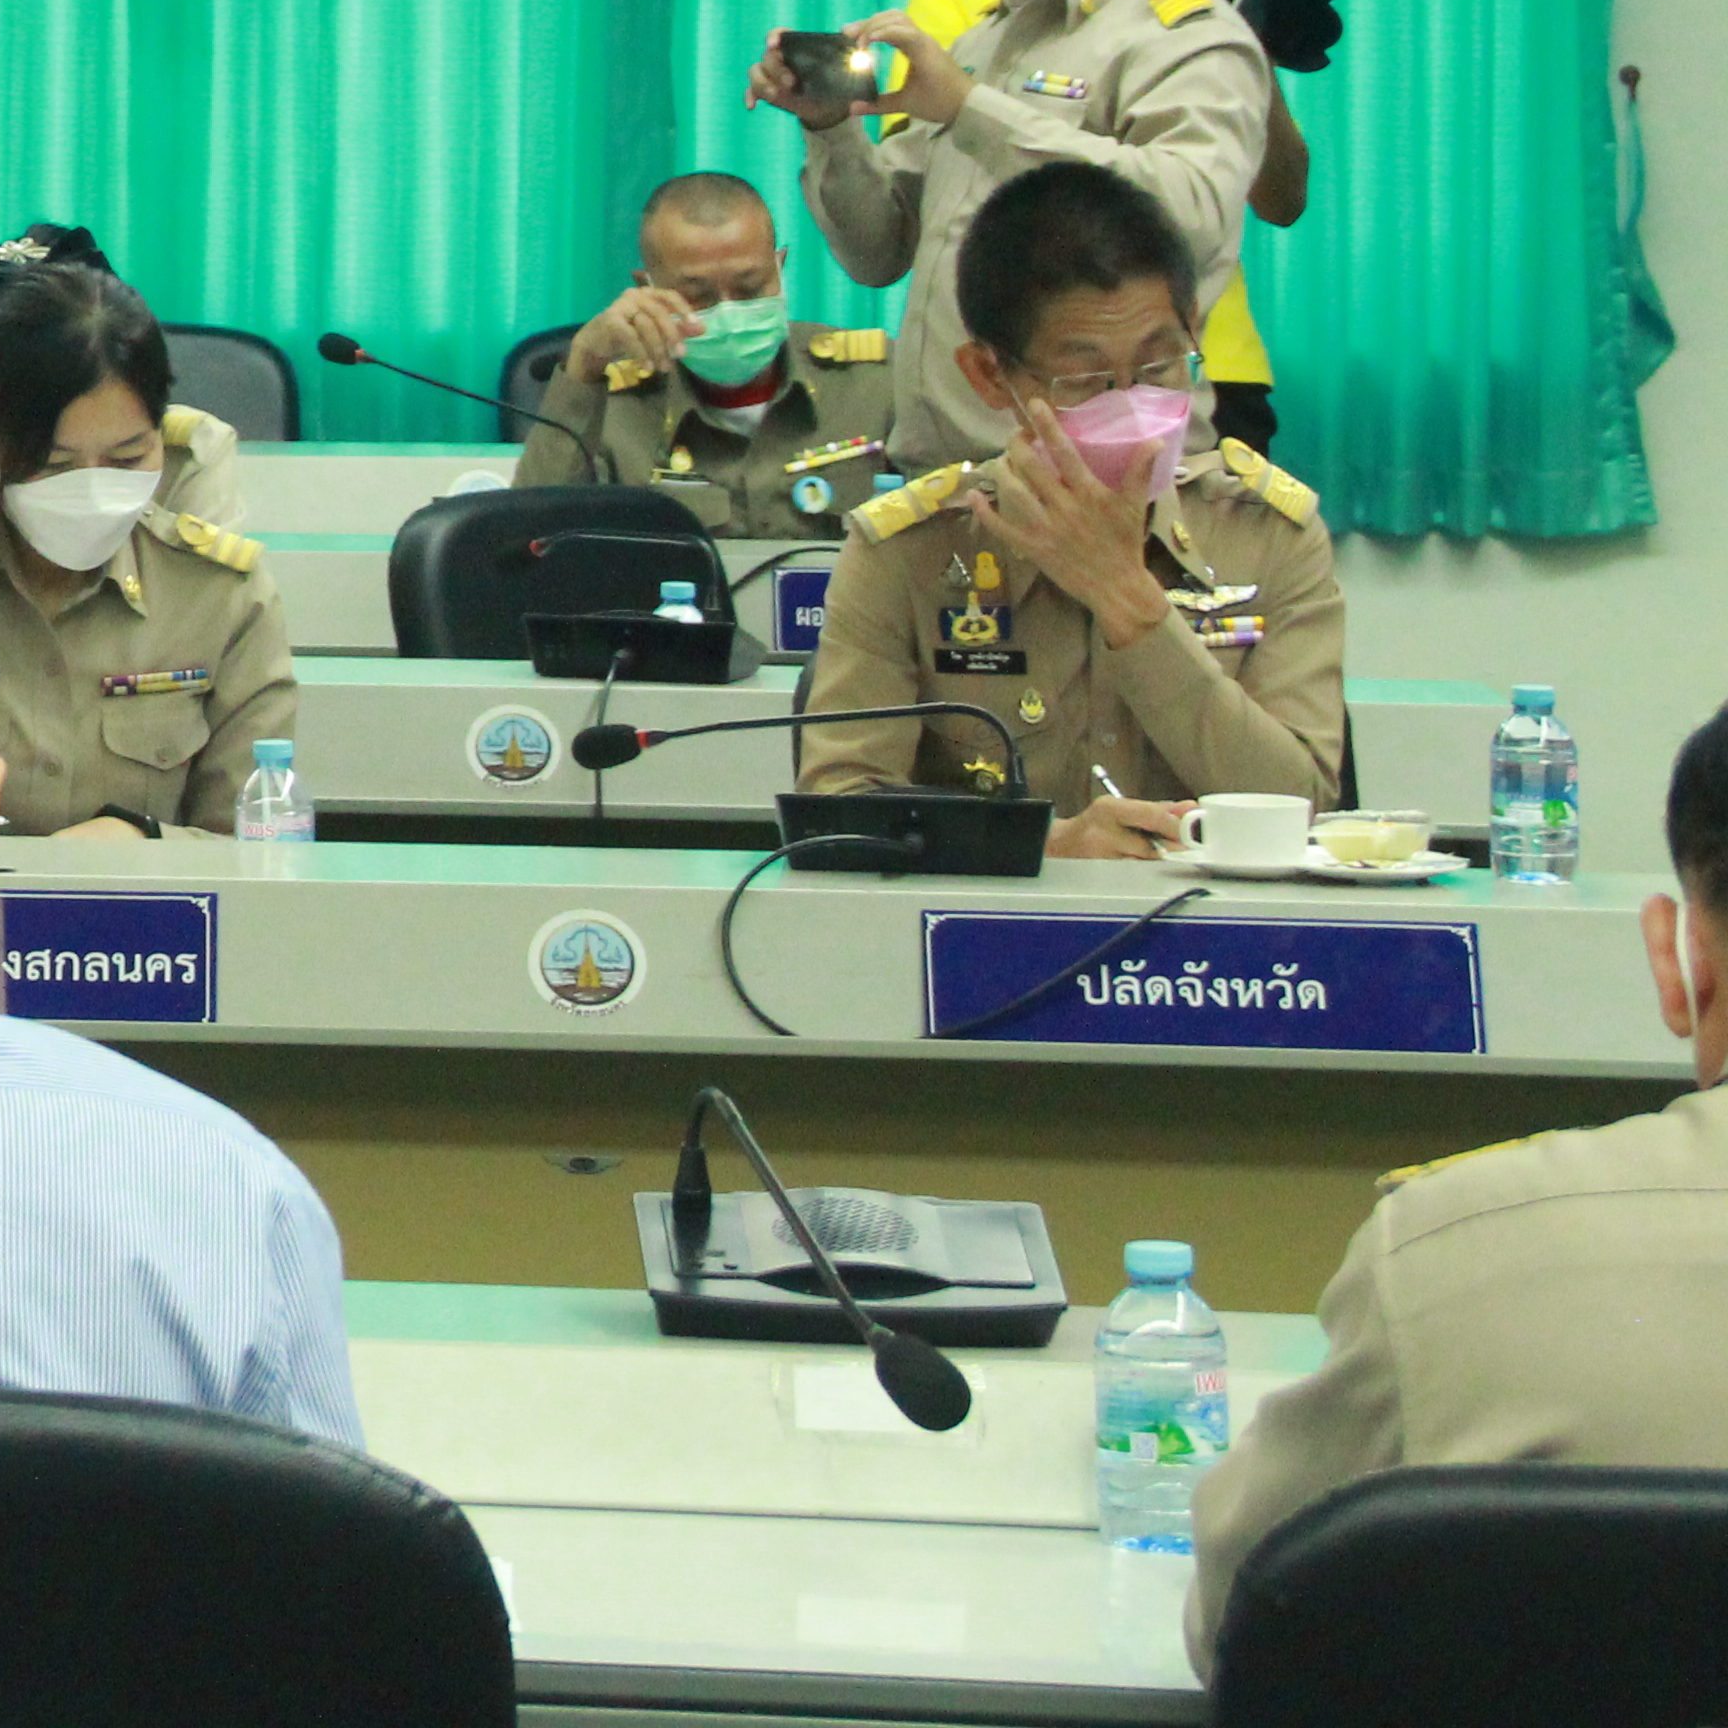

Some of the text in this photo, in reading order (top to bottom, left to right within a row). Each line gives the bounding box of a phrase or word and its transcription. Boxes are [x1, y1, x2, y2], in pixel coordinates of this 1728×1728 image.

[1075, 958, 1328, 1011] ปลัดจังหวัด
